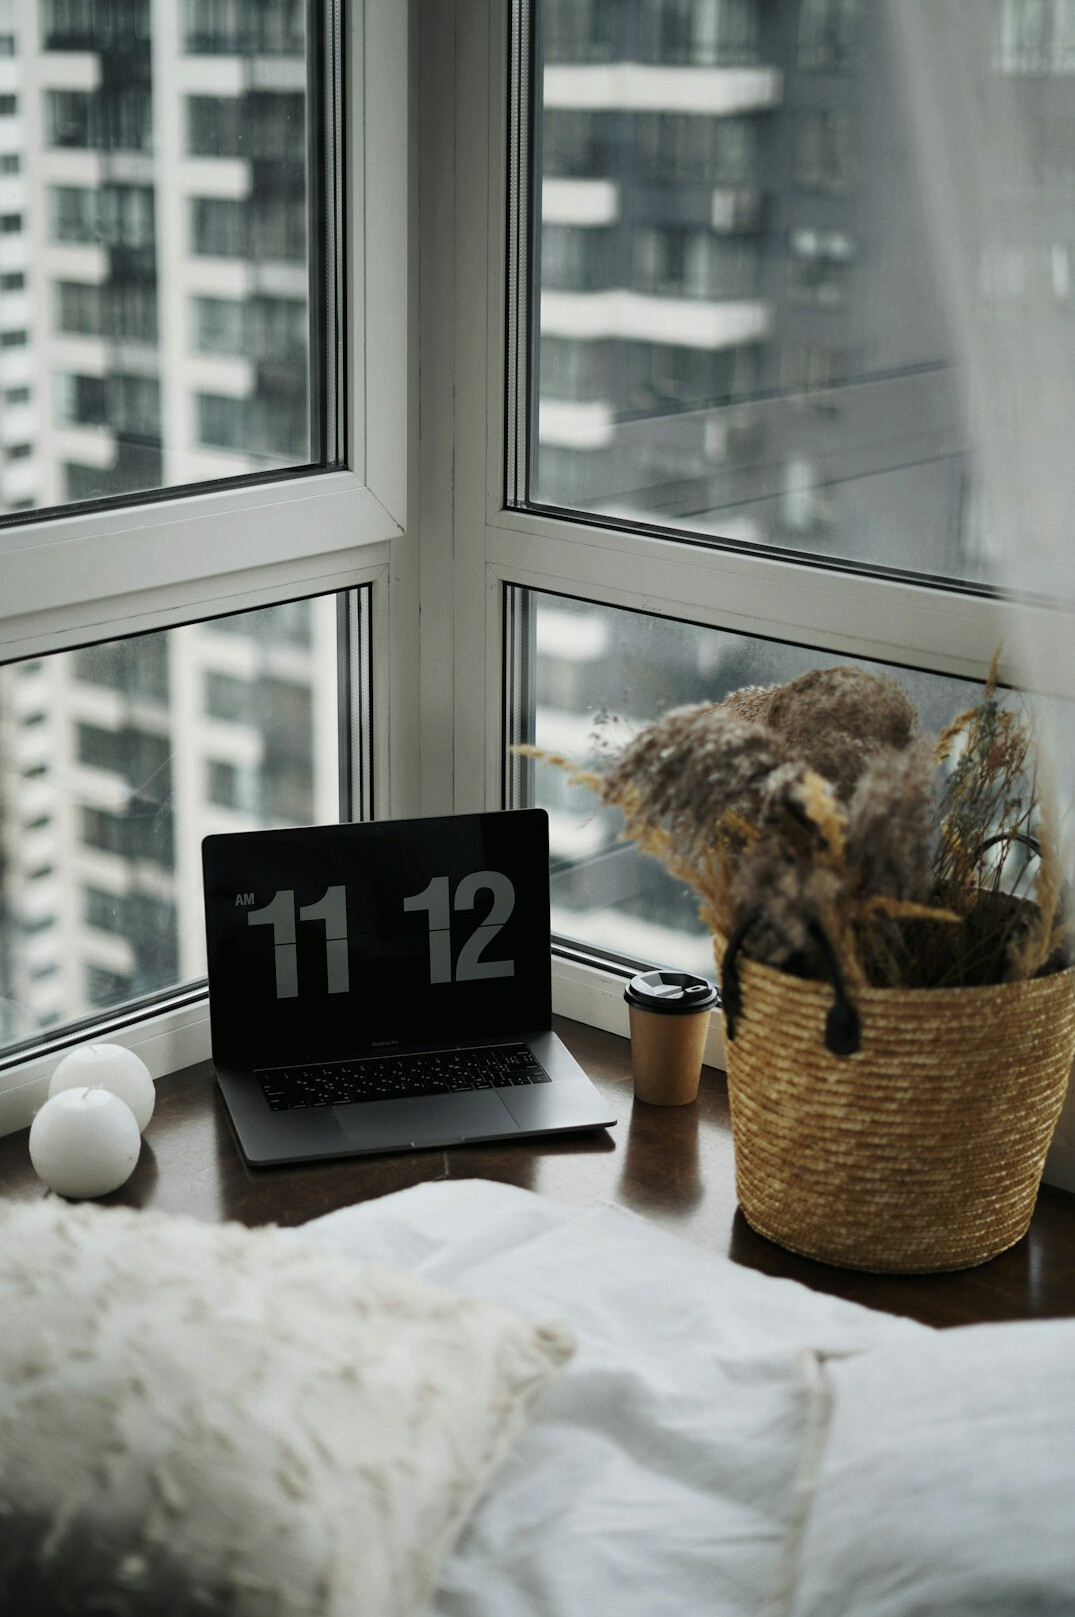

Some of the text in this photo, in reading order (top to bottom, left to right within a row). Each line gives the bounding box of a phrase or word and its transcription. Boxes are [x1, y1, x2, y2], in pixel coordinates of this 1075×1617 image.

[235, 892, 255, 906] AM
[248, 870, 516, 999] 11 12
